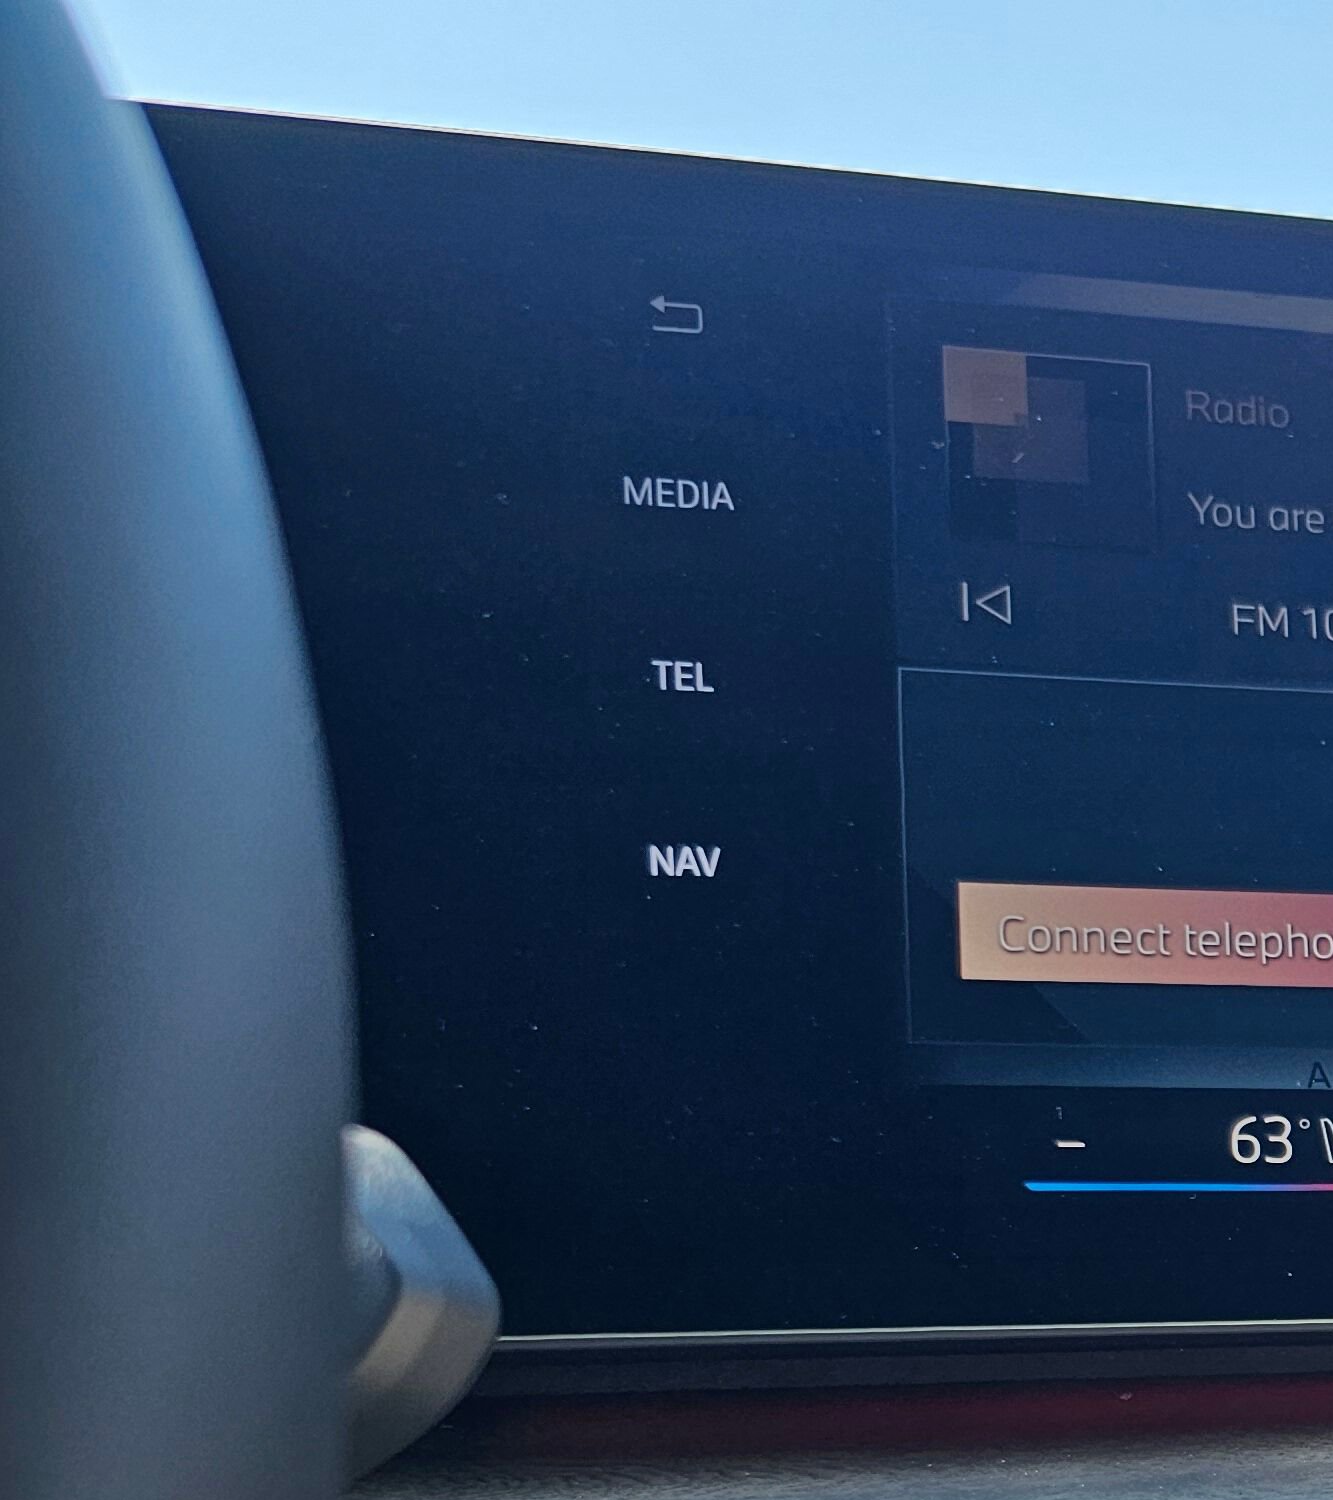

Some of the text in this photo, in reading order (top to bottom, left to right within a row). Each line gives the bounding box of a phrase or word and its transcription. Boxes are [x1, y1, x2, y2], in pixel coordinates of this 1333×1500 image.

[1186, 389, 1290, 429] Radio
[622, 476, 735, 511] MEDIA
[1187, 491, 1255, 529] You
[1269, 505, 1325, 534] are
[1231, 603, 1290, 639] FM
[650, 659, 715, 693] TEL
[648, 845, 721, 878] NAV
[999, 914, 1171, 957] Connect
